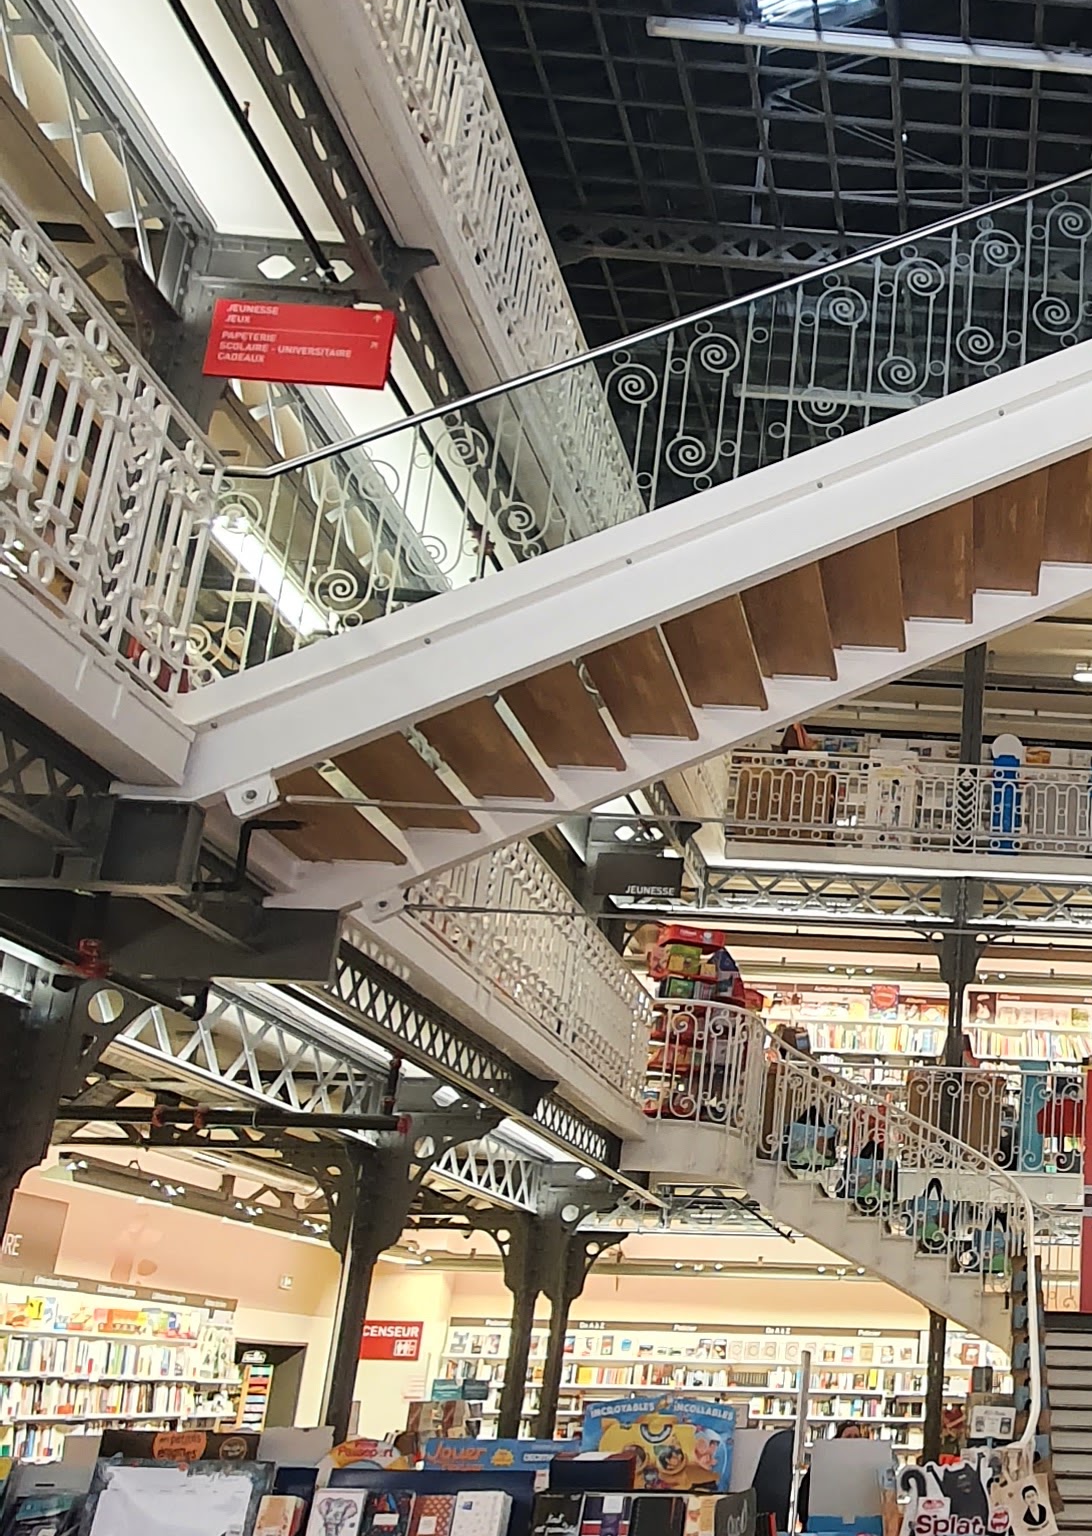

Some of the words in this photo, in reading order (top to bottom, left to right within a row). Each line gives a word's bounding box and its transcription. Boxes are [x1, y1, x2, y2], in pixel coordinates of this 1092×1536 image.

[226, 303, 279, 315] JEUNESSE
[225, 315, 251, 324] JEUX
[221, 330, 277, 343] PAPETERIE
[219, 341, 269, 353] SCOLAIRE
[277, 345, 352, 358] UNIVERSITAIRE
[217, 352, 265, 364] CADEAUX
[625, 885, 676, 896] JEUNESSE
[915, 1514, 985, 1536] Splat
